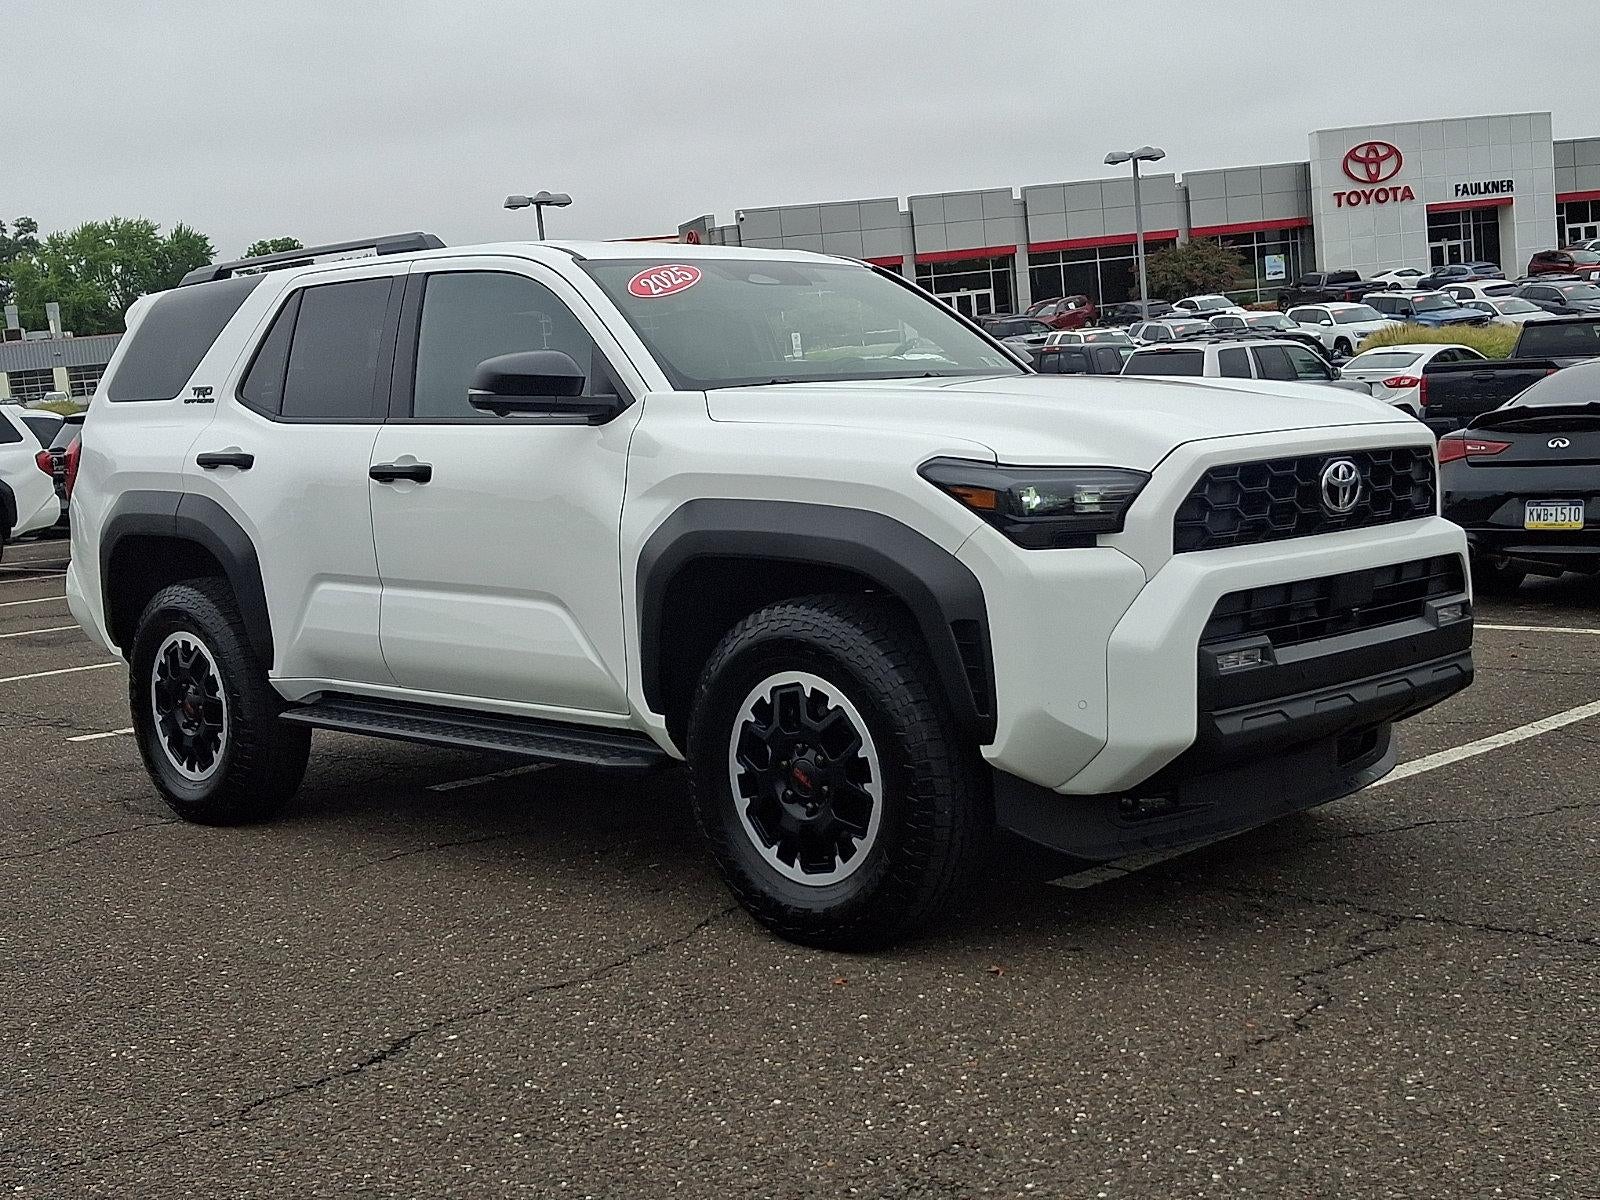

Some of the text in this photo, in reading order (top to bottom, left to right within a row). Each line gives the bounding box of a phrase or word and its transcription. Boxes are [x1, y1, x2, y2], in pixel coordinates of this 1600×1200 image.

[1333, 185, 1415, 208] TOYOTA
[1454, 179, 1514, 197] FAULKNER
[640, 266, 693, 295] 2025
[192, 386, 213, 398] TRD
